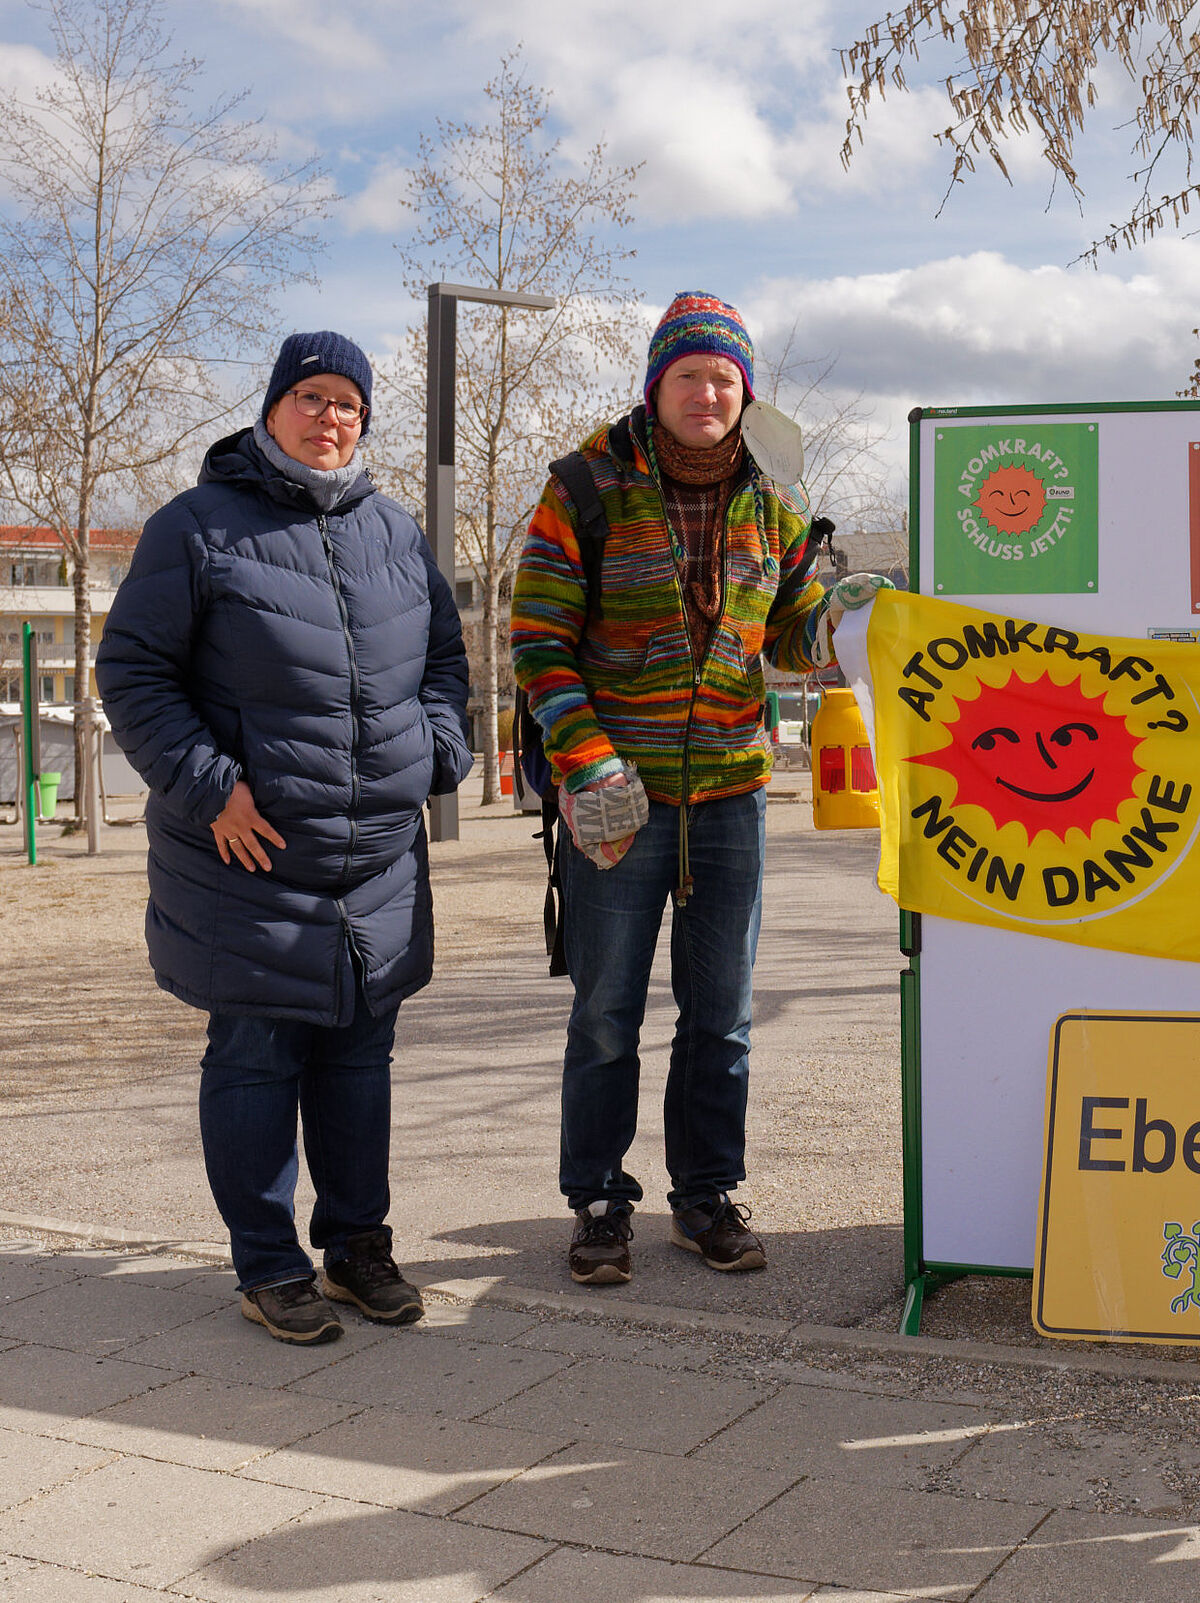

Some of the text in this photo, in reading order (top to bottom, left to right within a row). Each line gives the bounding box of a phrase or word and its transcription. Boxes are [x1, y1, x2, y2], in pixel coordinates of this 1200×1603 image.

[958, 438, 1069, 498] ATOMKRAFT?
[957, 506, 1074, 560] SCHLUSS JETZT!
[898, 619, 1189, 733] ATOMKRAFT?
[910, 774, 1192, 906] NEIN DANKE
